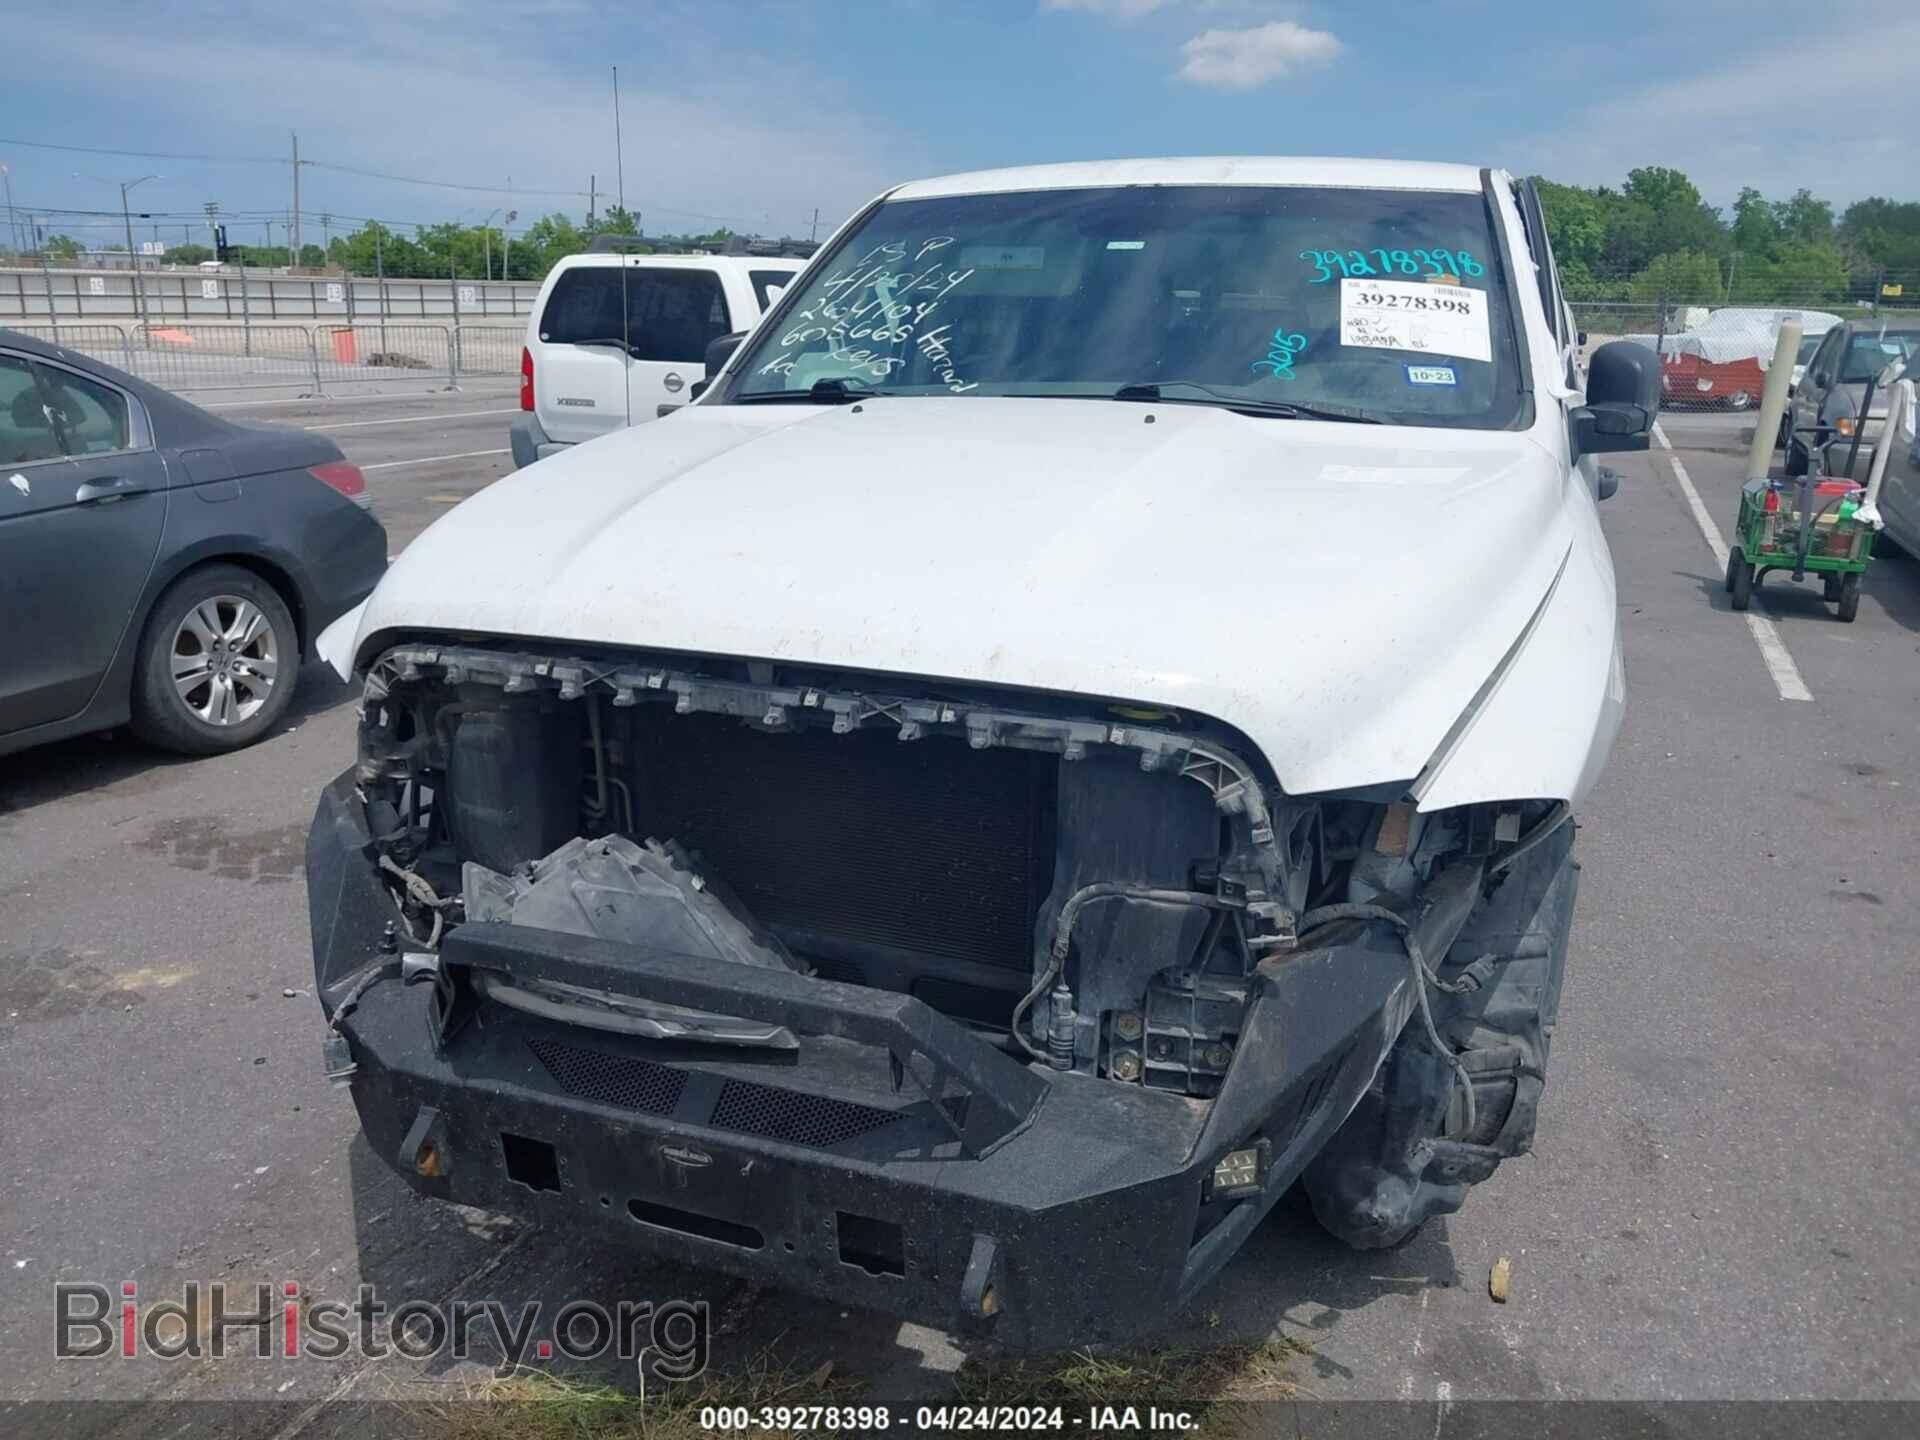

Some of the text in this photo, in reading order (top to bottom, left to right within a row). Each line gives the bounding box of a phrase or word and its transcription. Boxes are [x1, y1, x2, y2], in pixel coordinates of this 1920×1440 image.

[1300, 248, 1484, 283] 39278398
[1355, 292, 1472, 316] 39278398
[1250, 328, 1308, 381] 2015
[1412, 371, 1453, 382] 10-23
